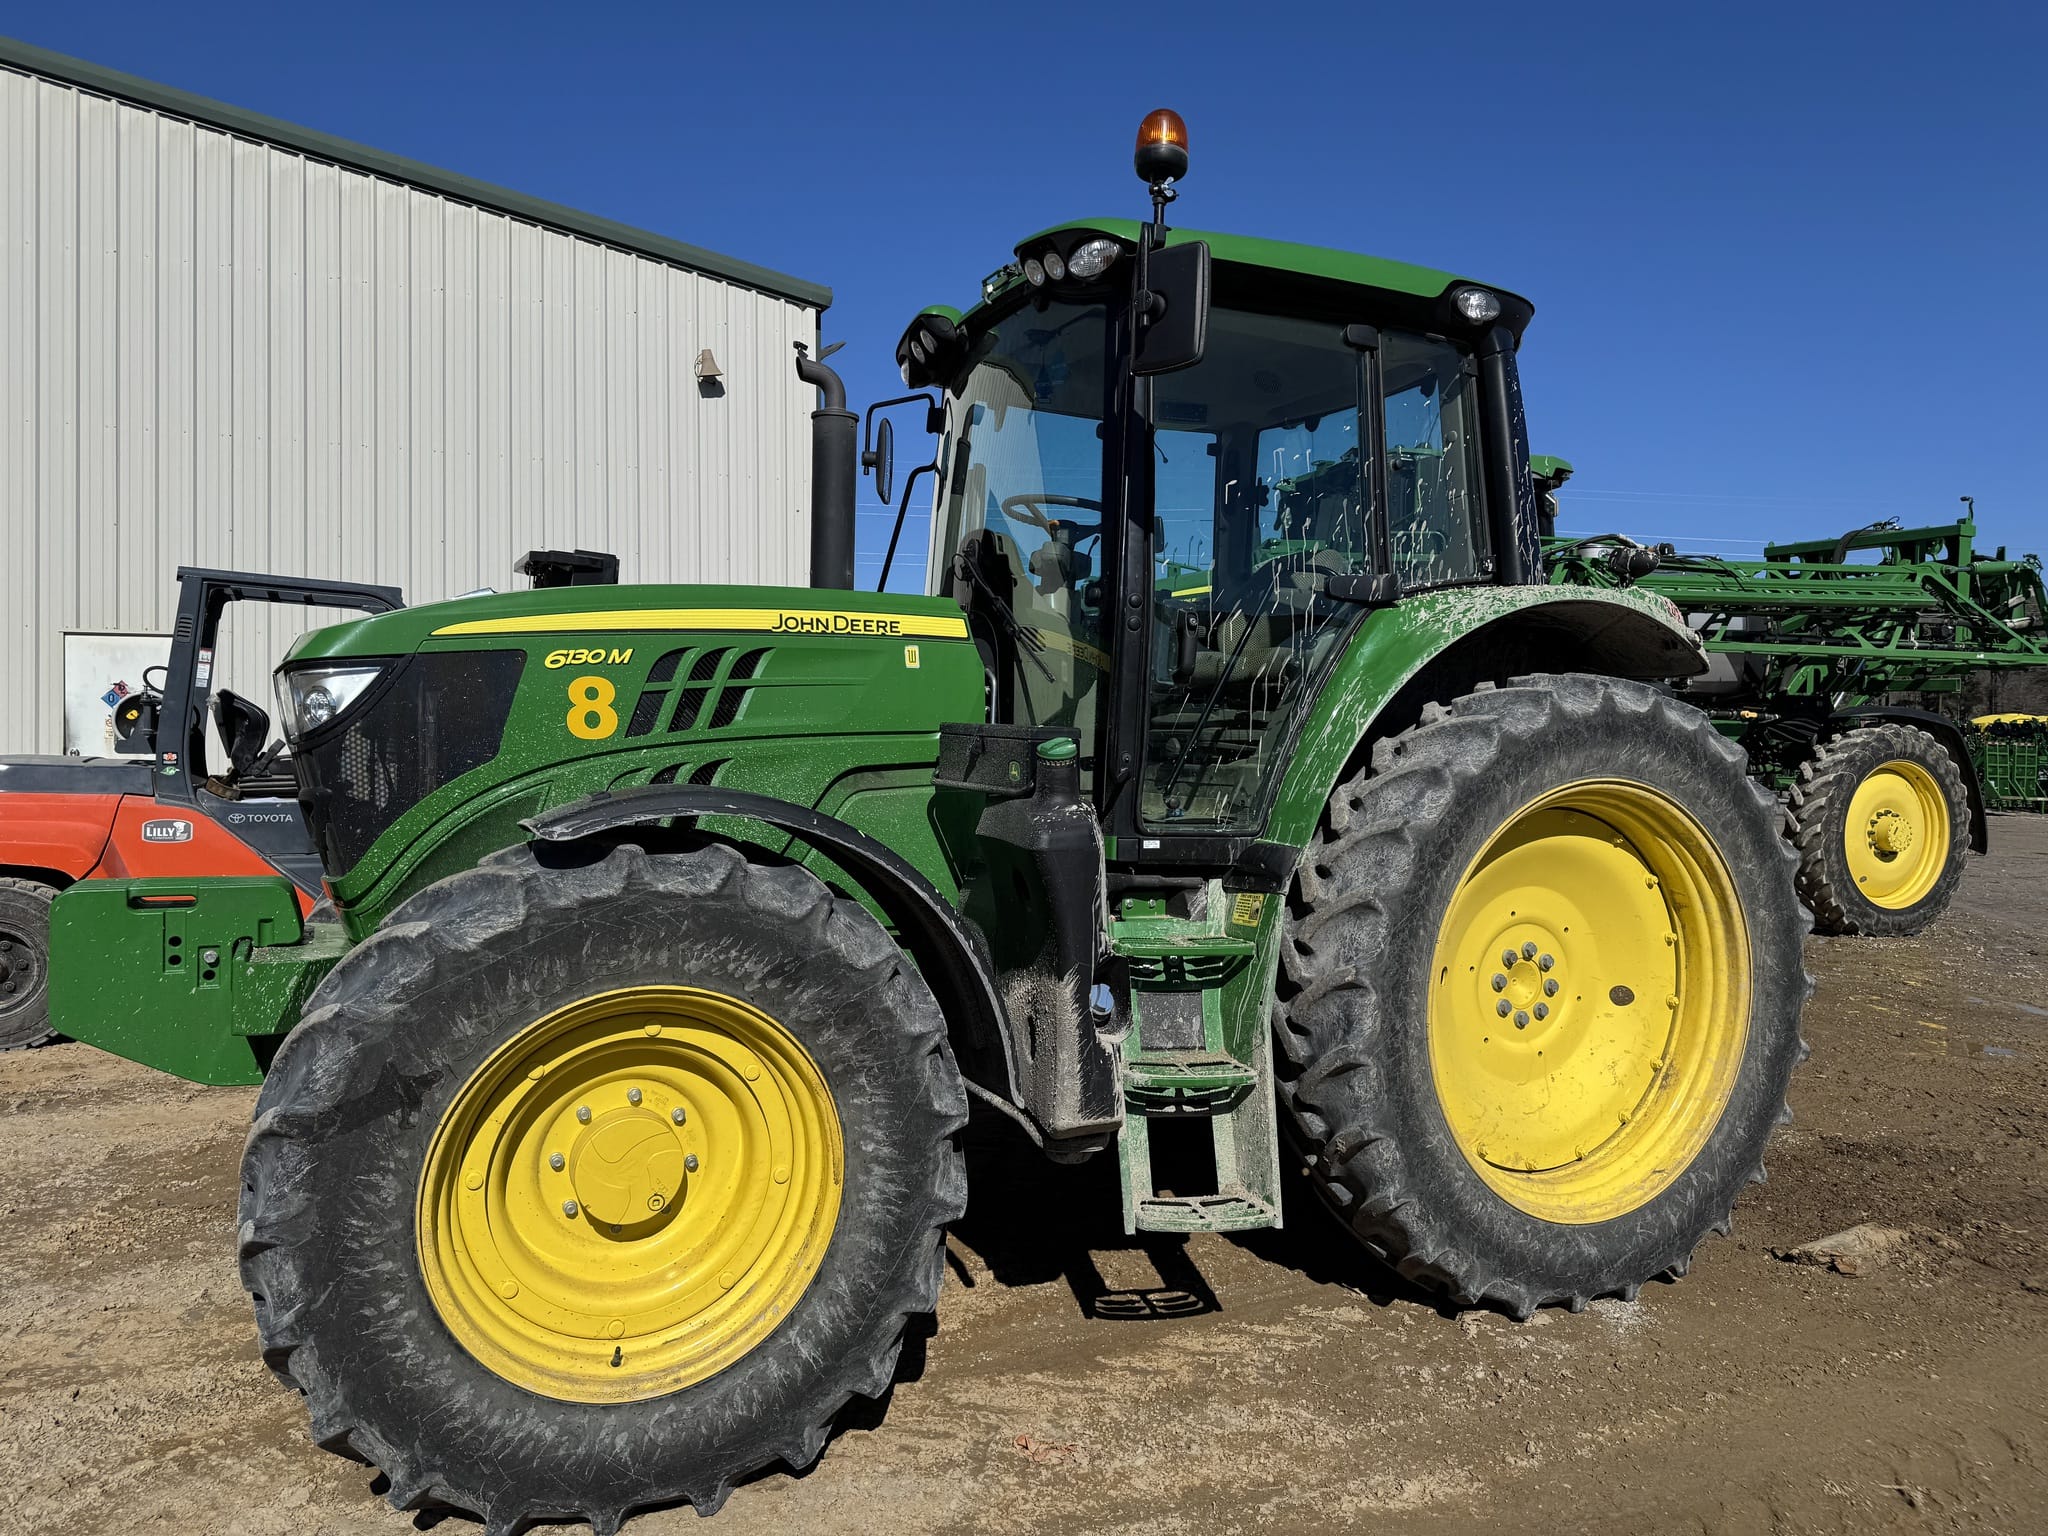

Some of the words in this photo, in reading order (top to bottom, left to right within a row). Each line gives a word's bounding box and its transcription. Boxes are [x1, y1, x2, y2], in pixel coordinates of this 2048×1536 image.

[771, 613, 829, 631] JOHN
[834, 615, 901, 633] DEERE
[544, 648, 607, 670] 6130
[607, 648, 635, 665] M
[108, 693, 115, 703] 0
[566, 675, 619, 740] 8
[248, 814, 293, 823] TOYOTA
[146, 826, 175, 837] LILLY
